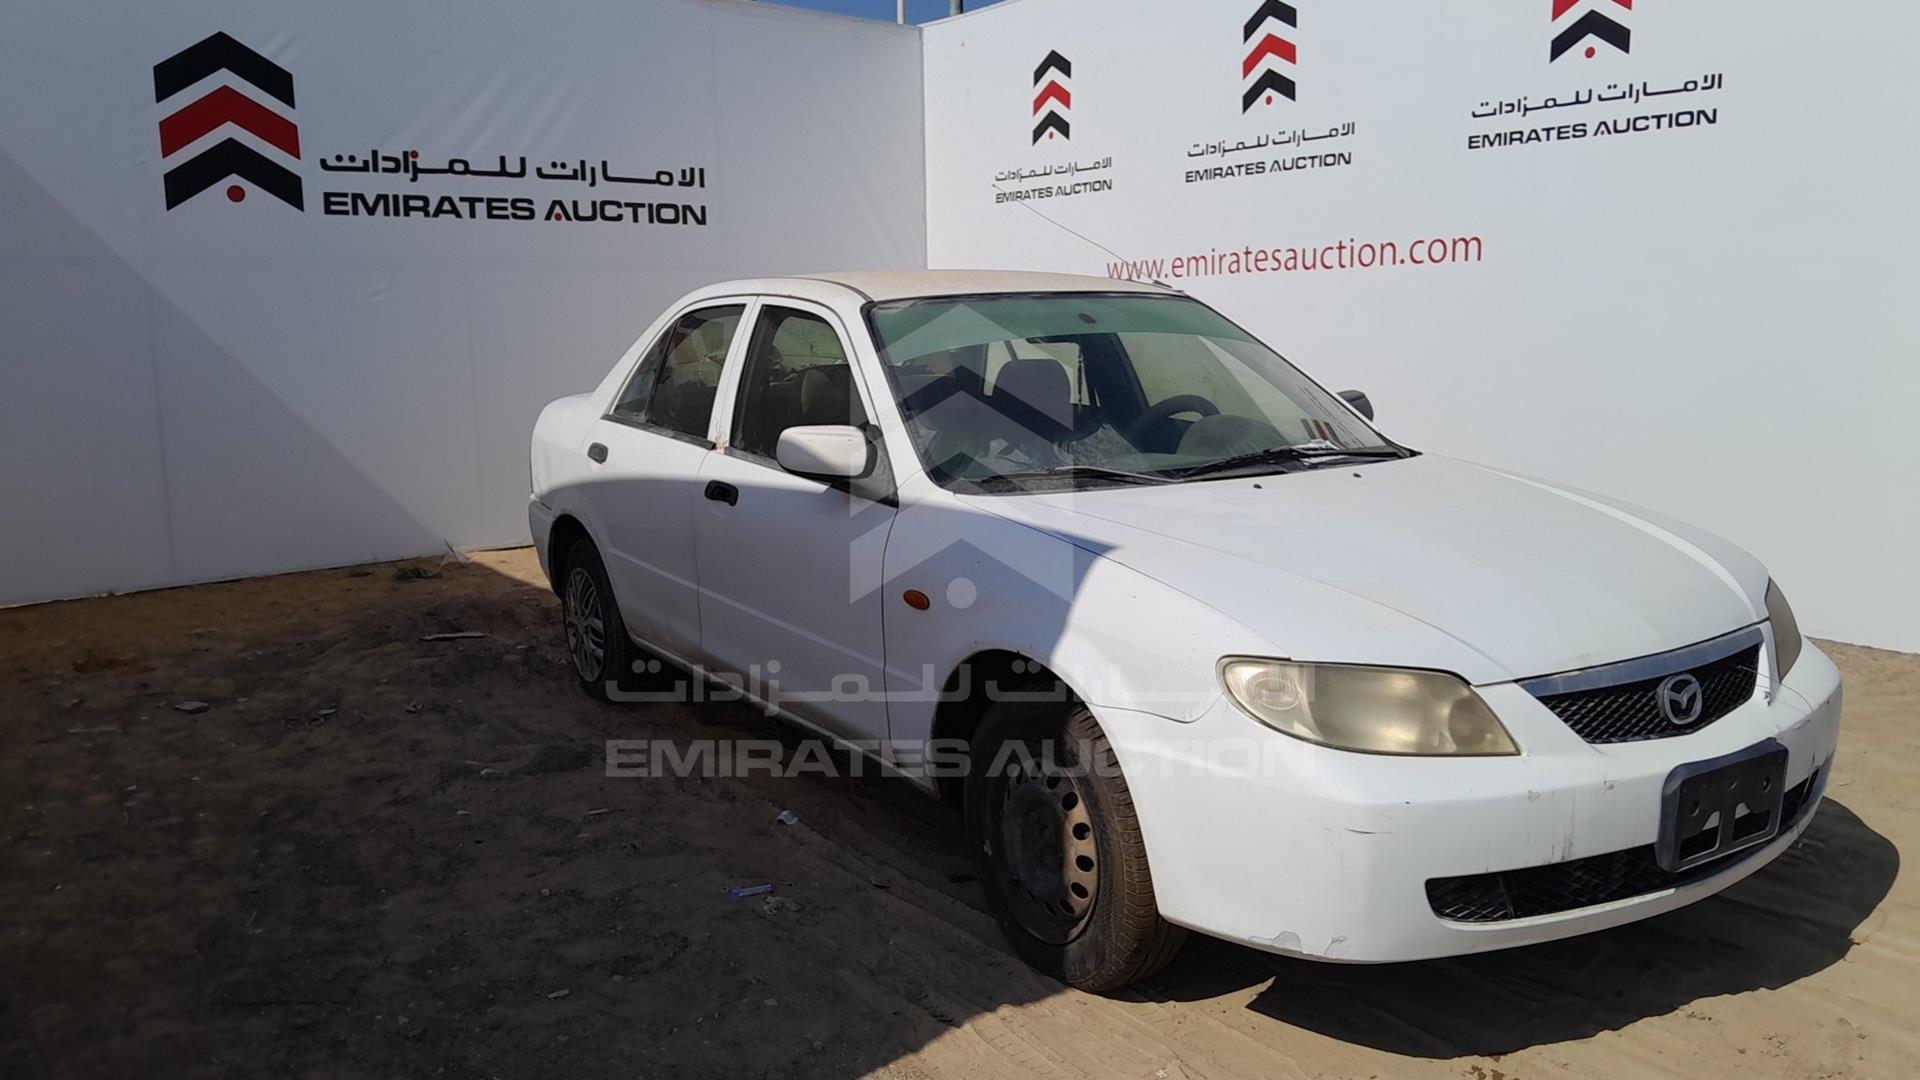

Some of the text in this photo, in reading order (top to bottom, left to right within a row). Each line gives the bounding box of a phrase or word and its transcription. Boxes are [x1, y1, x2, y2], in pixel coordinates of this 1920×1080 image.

[1471, 73, 1722, 118] الامارات للمزادات
[1187, 121, 1355, 158] الامارات للمزادات
[1468, 108, 1717, 150] EMIRATES AUCTION
[319, 149, 705, 188] الامارات للمزادات
[1185, 151, 1352, 183] EMIRATES AUCTION
[323, 191, 707, 226] EMIRATES AUCTION
[995, 179, 1112, 204] EMIRATES AUCTION
[1106, 235, 1483, 281] www.emiratesauction.com
